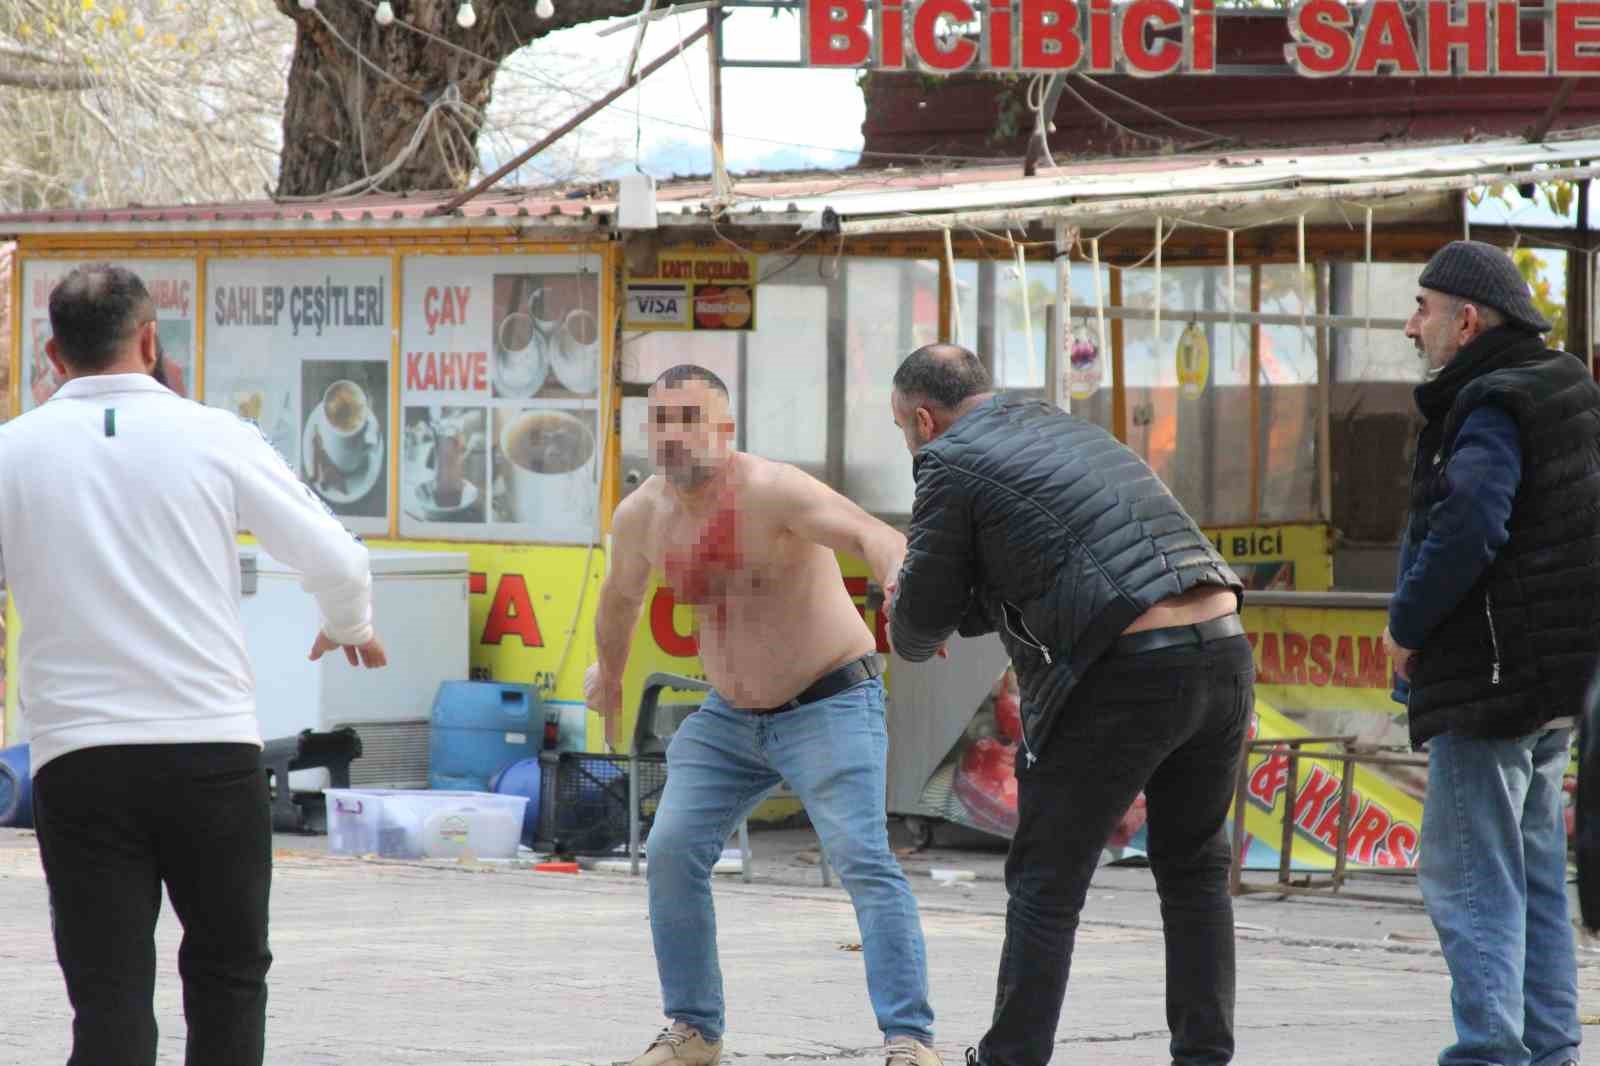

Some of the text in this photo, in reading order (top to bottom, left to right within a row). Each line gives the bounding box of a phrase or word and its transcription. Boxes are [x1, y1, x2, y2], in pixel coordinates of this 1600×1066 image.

[214, 274, 384, 337] SAHLEP ÇEŞİTLERİ
[423, 286, 472, 335] ÇAY
[636, 297, 678, 313] VISA
[406, 351, 488, 392] KAHVE
[1231, 529, 1283, 557] BİCİ
